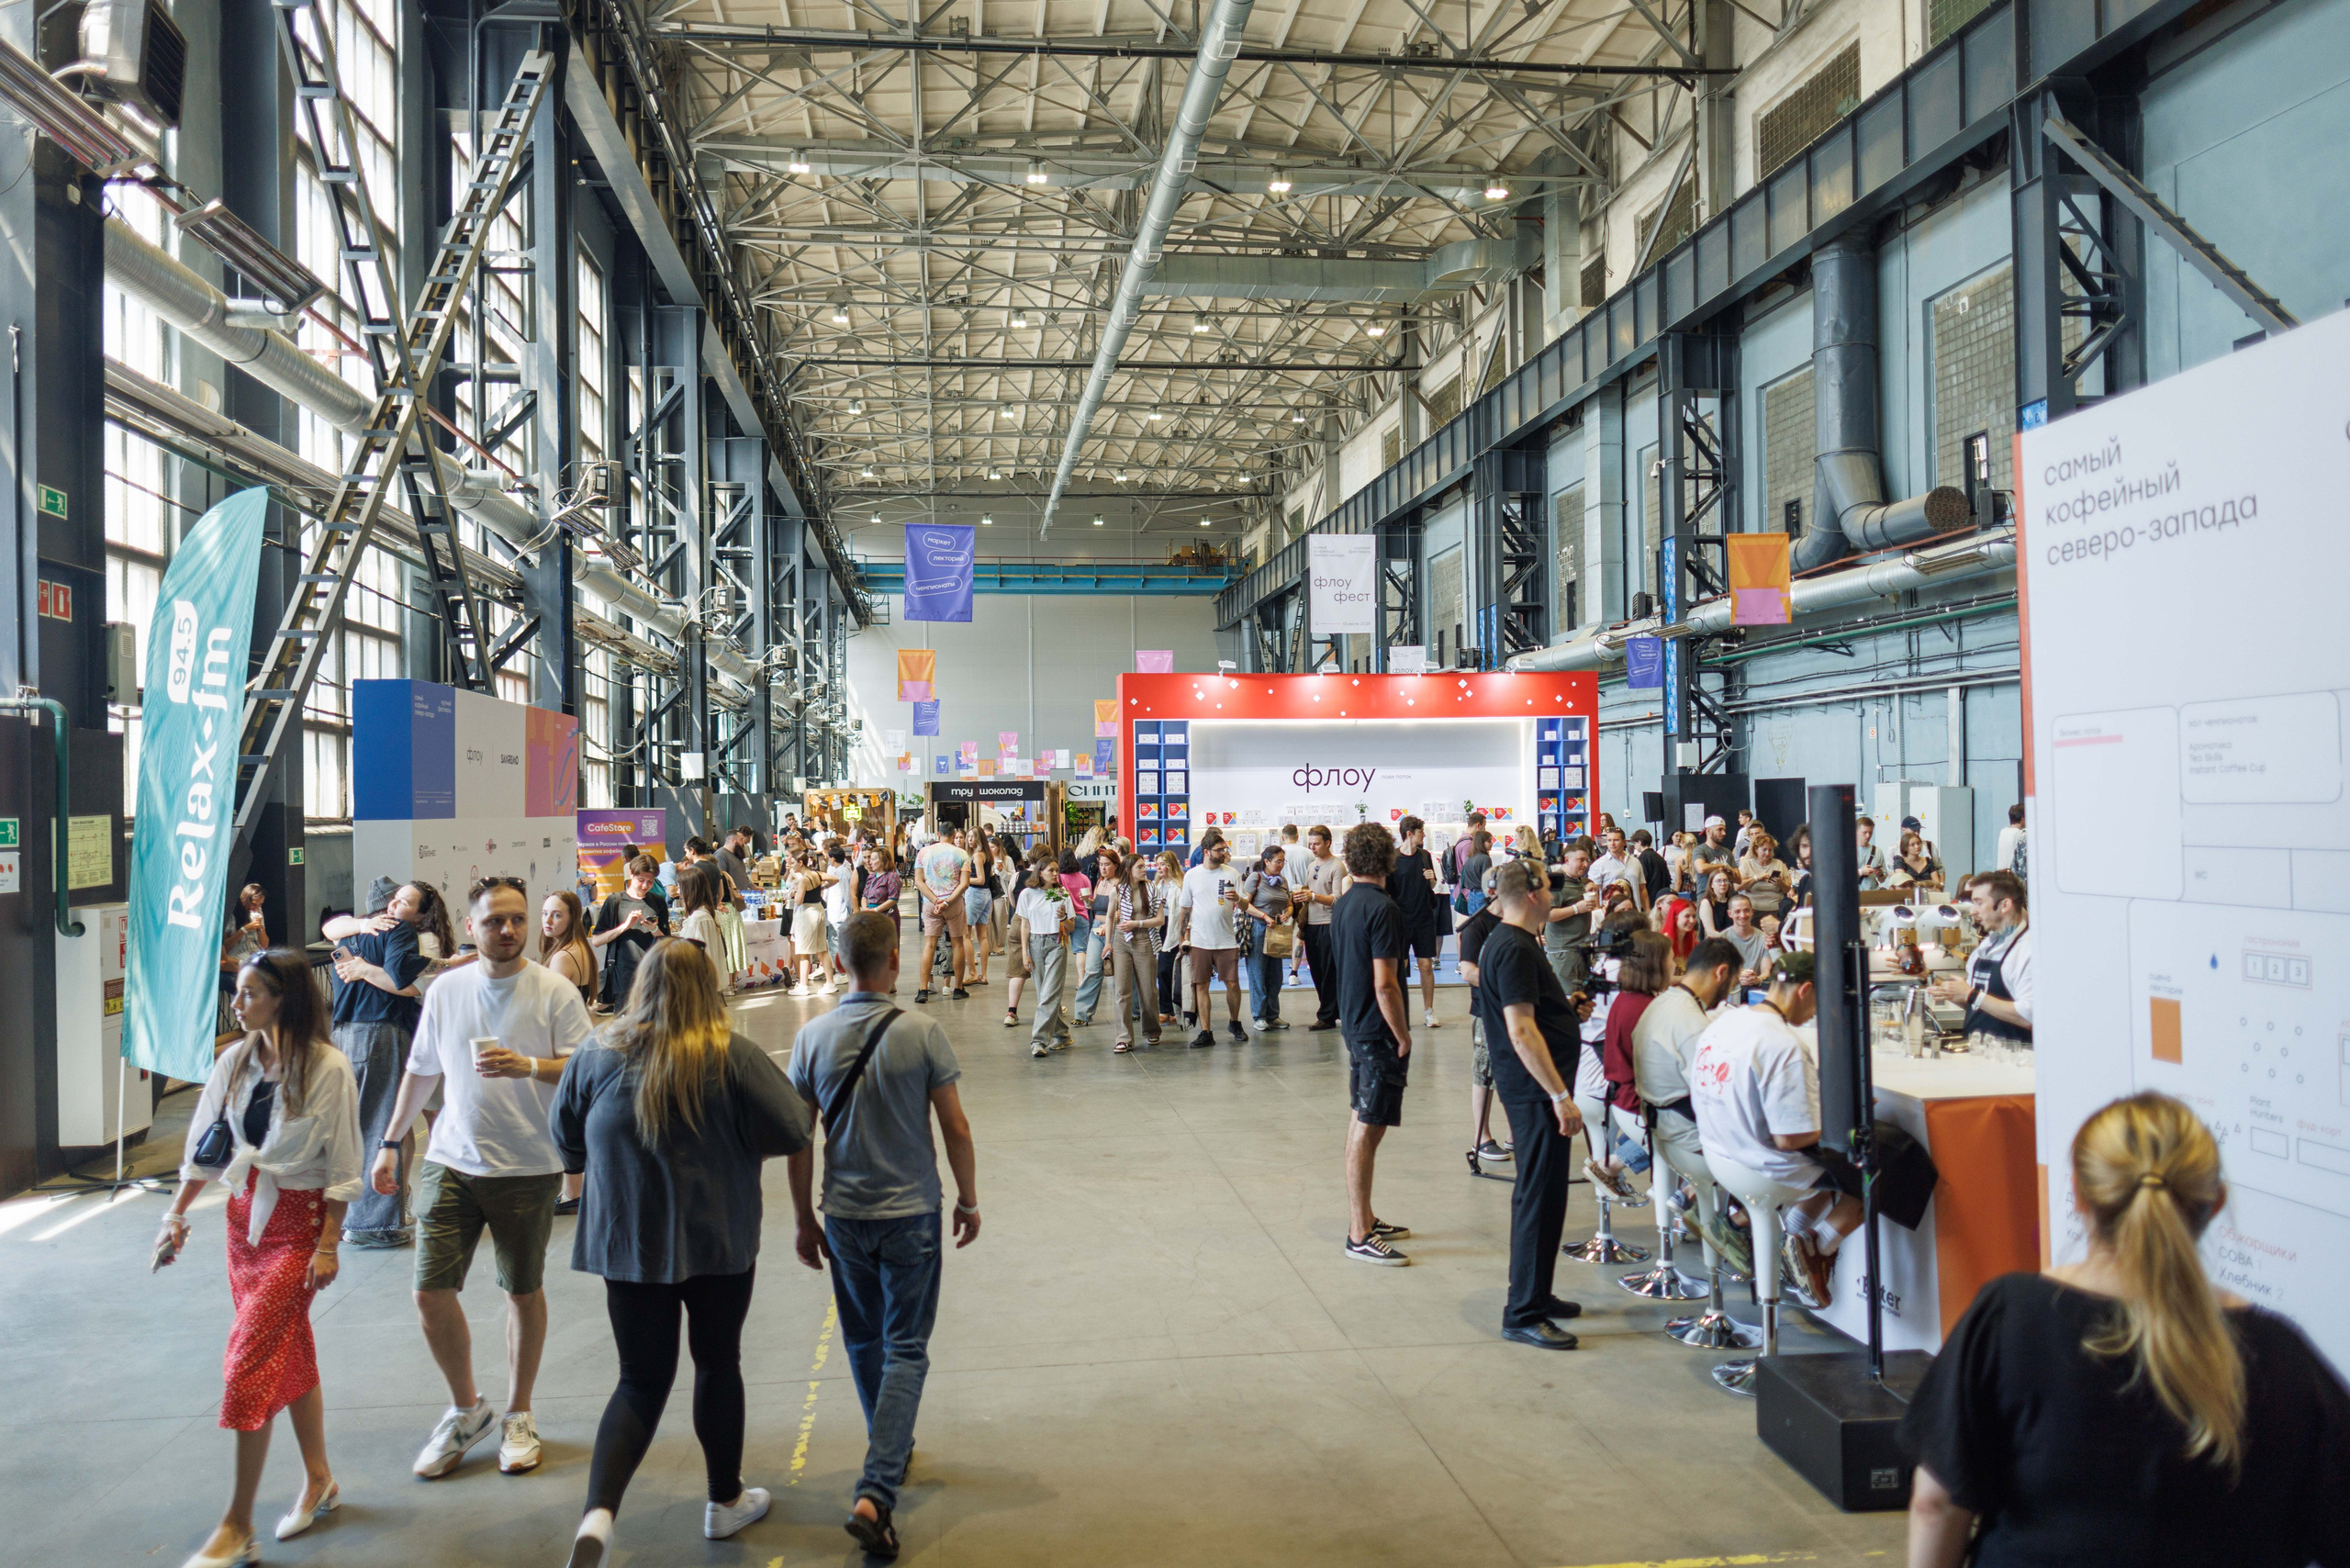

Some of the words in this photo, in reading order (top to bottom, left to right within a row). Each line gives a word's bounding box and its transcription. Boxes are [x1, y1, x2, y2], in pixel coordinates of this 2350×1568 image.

[2044, 434, 2122, 486] самый
[2045, 459, 2181, 527] кофейный
[2047, 494, 2258, 566] северо-запада
[927, 537, 952, 546] маркет
[933, 554, 965, 563] лекторий
[915, 582, 956, 591] чемпионаты
[1314, 576, 1352, 590] флоу
[1334, 590, 1371, 605] фест
[173, 616, 193, 687] 94.5
[466, 745, 484, 766] флоу
[2218, 763, 2247, 774] Coffee
[2250, 763, 2267, 775] Cup
[1292, 762, 1376, 793] флоу
[588, 823, 632, 832] CafeStore
[2273, 964, 2278, 974] 2
[2295, 967, 2301, 977] 3
[2149, 984, 2184, 995] лектория
[2249, 1096, 2271, 1109] Plant
[2250, 1110, 2284, 1124] Hunters
[2296, 1118, 2342, 1138] фуд-корт
[2218, 1246, 2254, 1269] СОВА
[2219, 1266, 2273, 1297] Хлебник
[2276, 1287, 2284, 1301] 2
[1862, 1274, 1901, 1311] Bter
